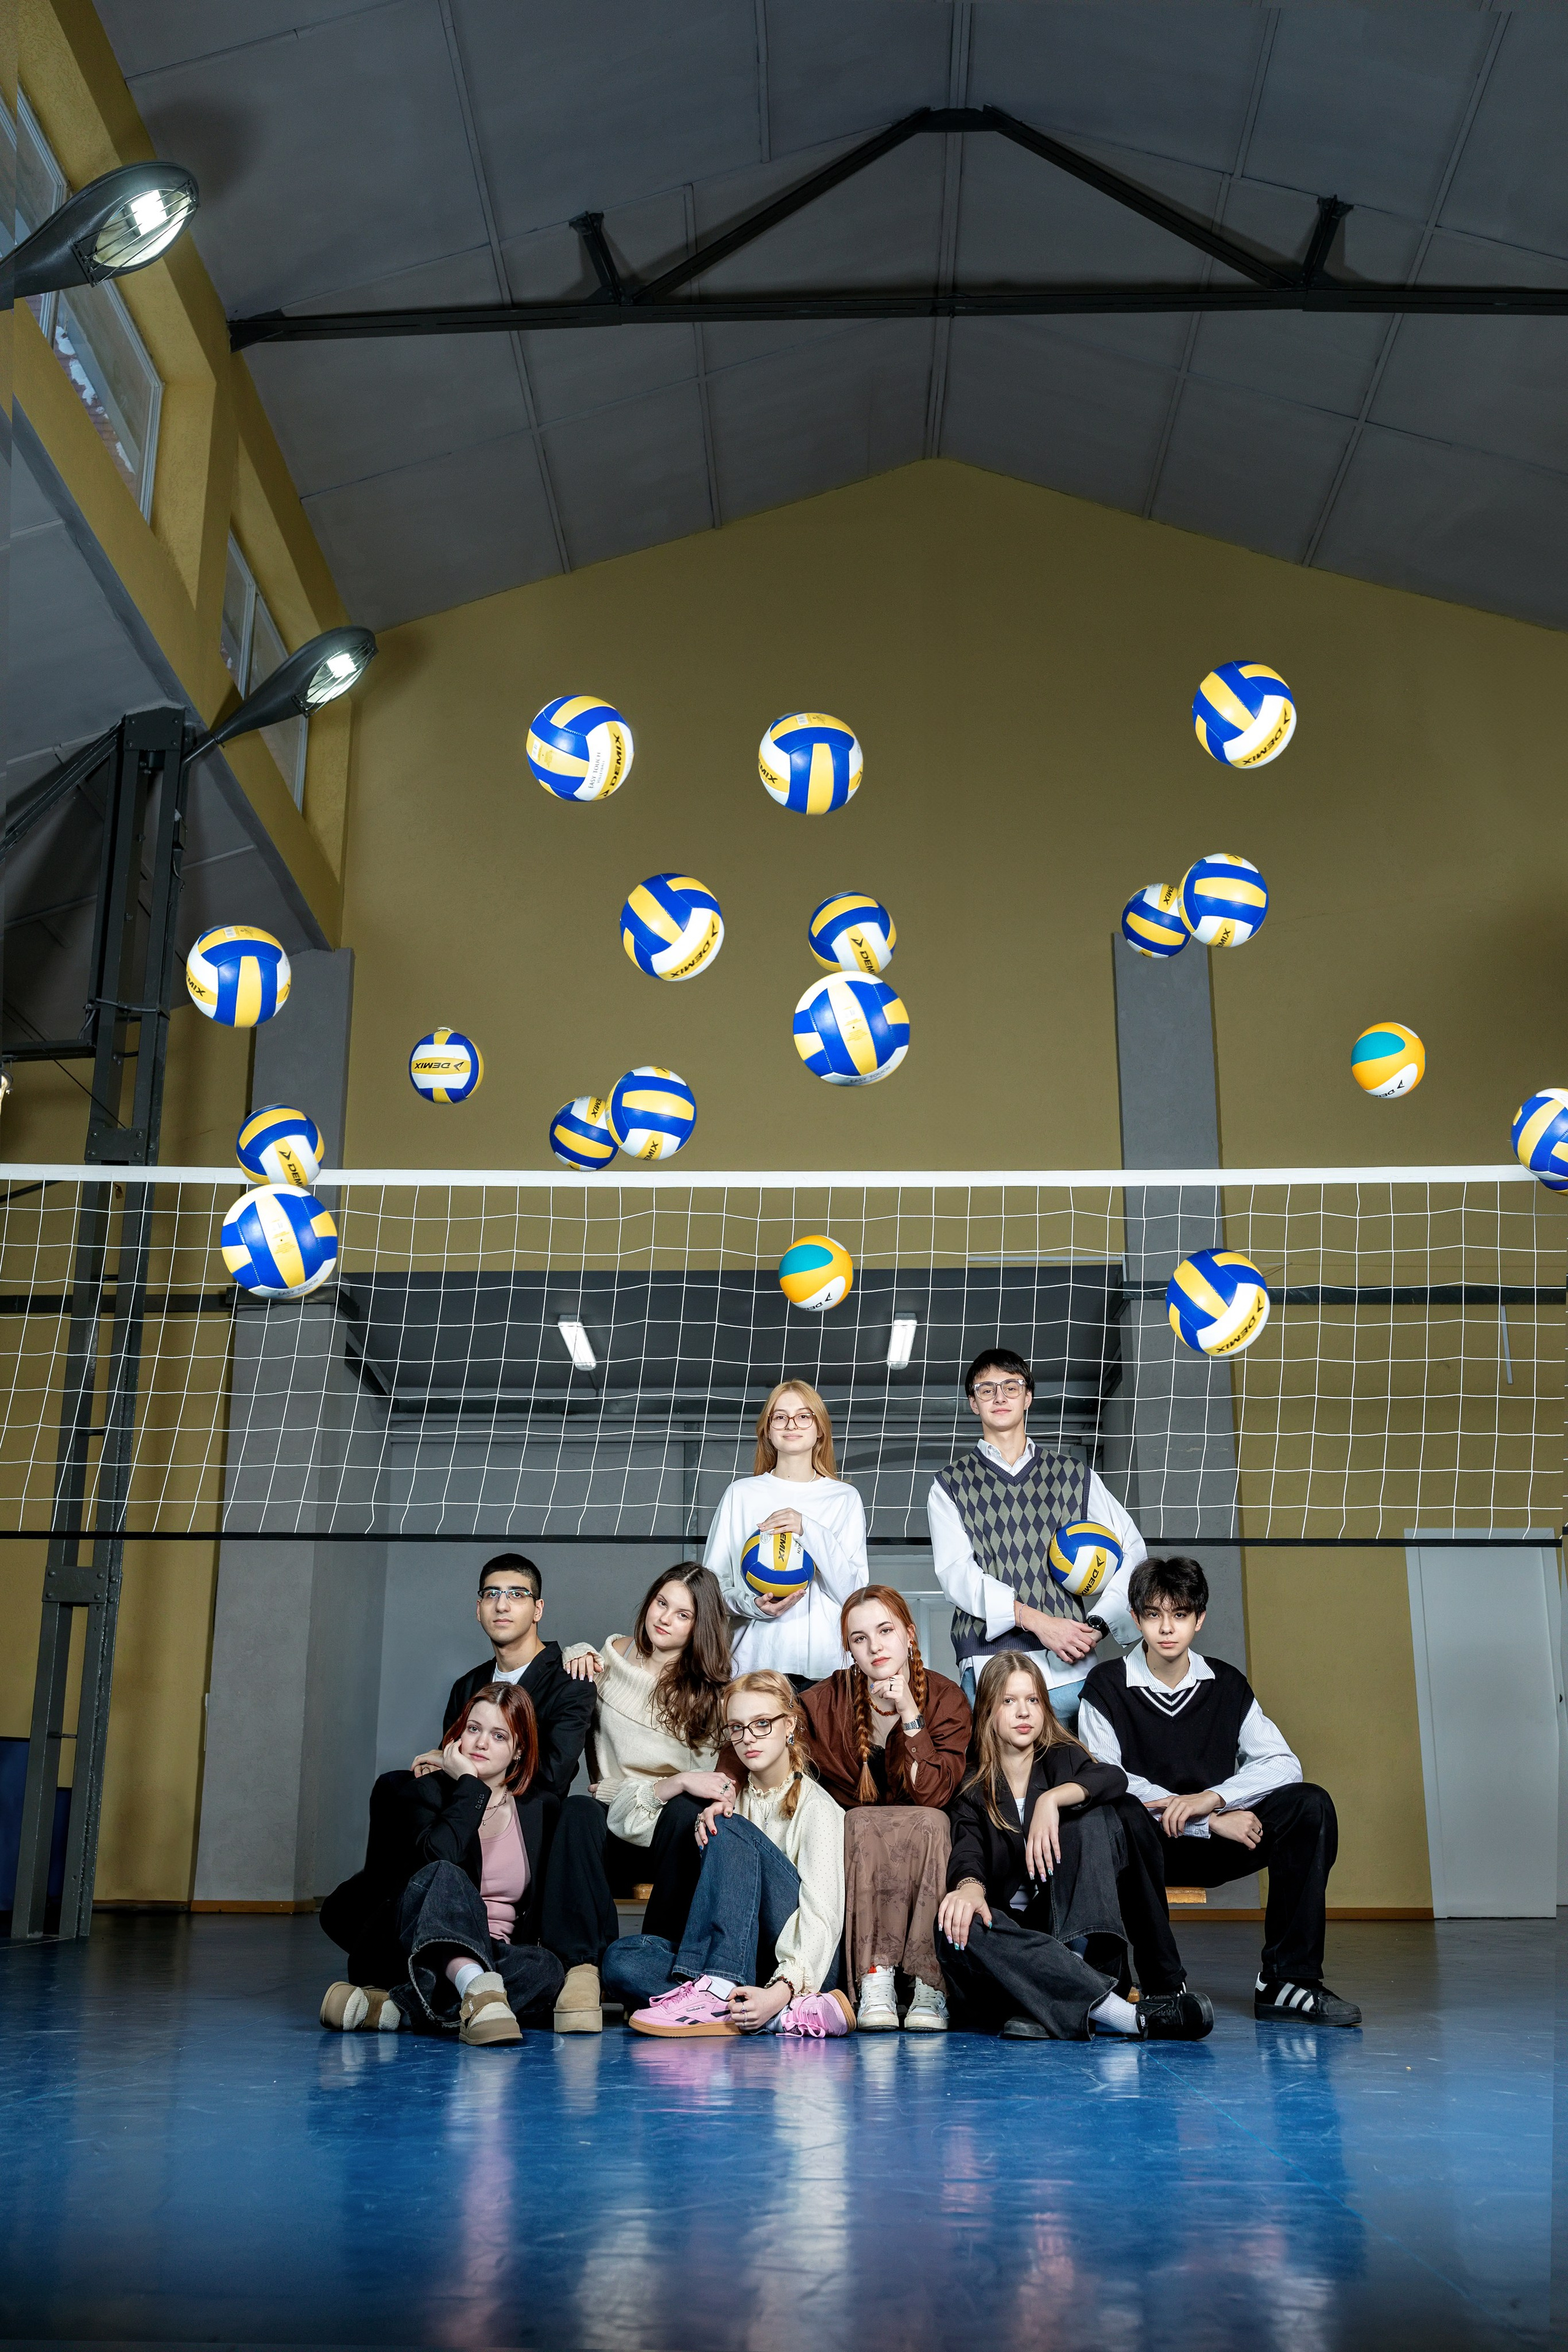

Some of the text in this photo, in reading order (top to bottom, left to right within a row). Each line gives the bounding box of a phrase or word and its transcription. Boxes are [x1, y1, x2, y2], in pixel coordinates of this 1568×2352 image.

[609, 733, 622, 786] DEMIX
[1242, 727, 1283, 765] DEMIX
[759, 761, 778, 784] MIX
[670, 940, 710, 978] DEMIX
[1216, 1315, 1256, 1353] DEMIX
[778, 1532, 786, 1562] EMIX
